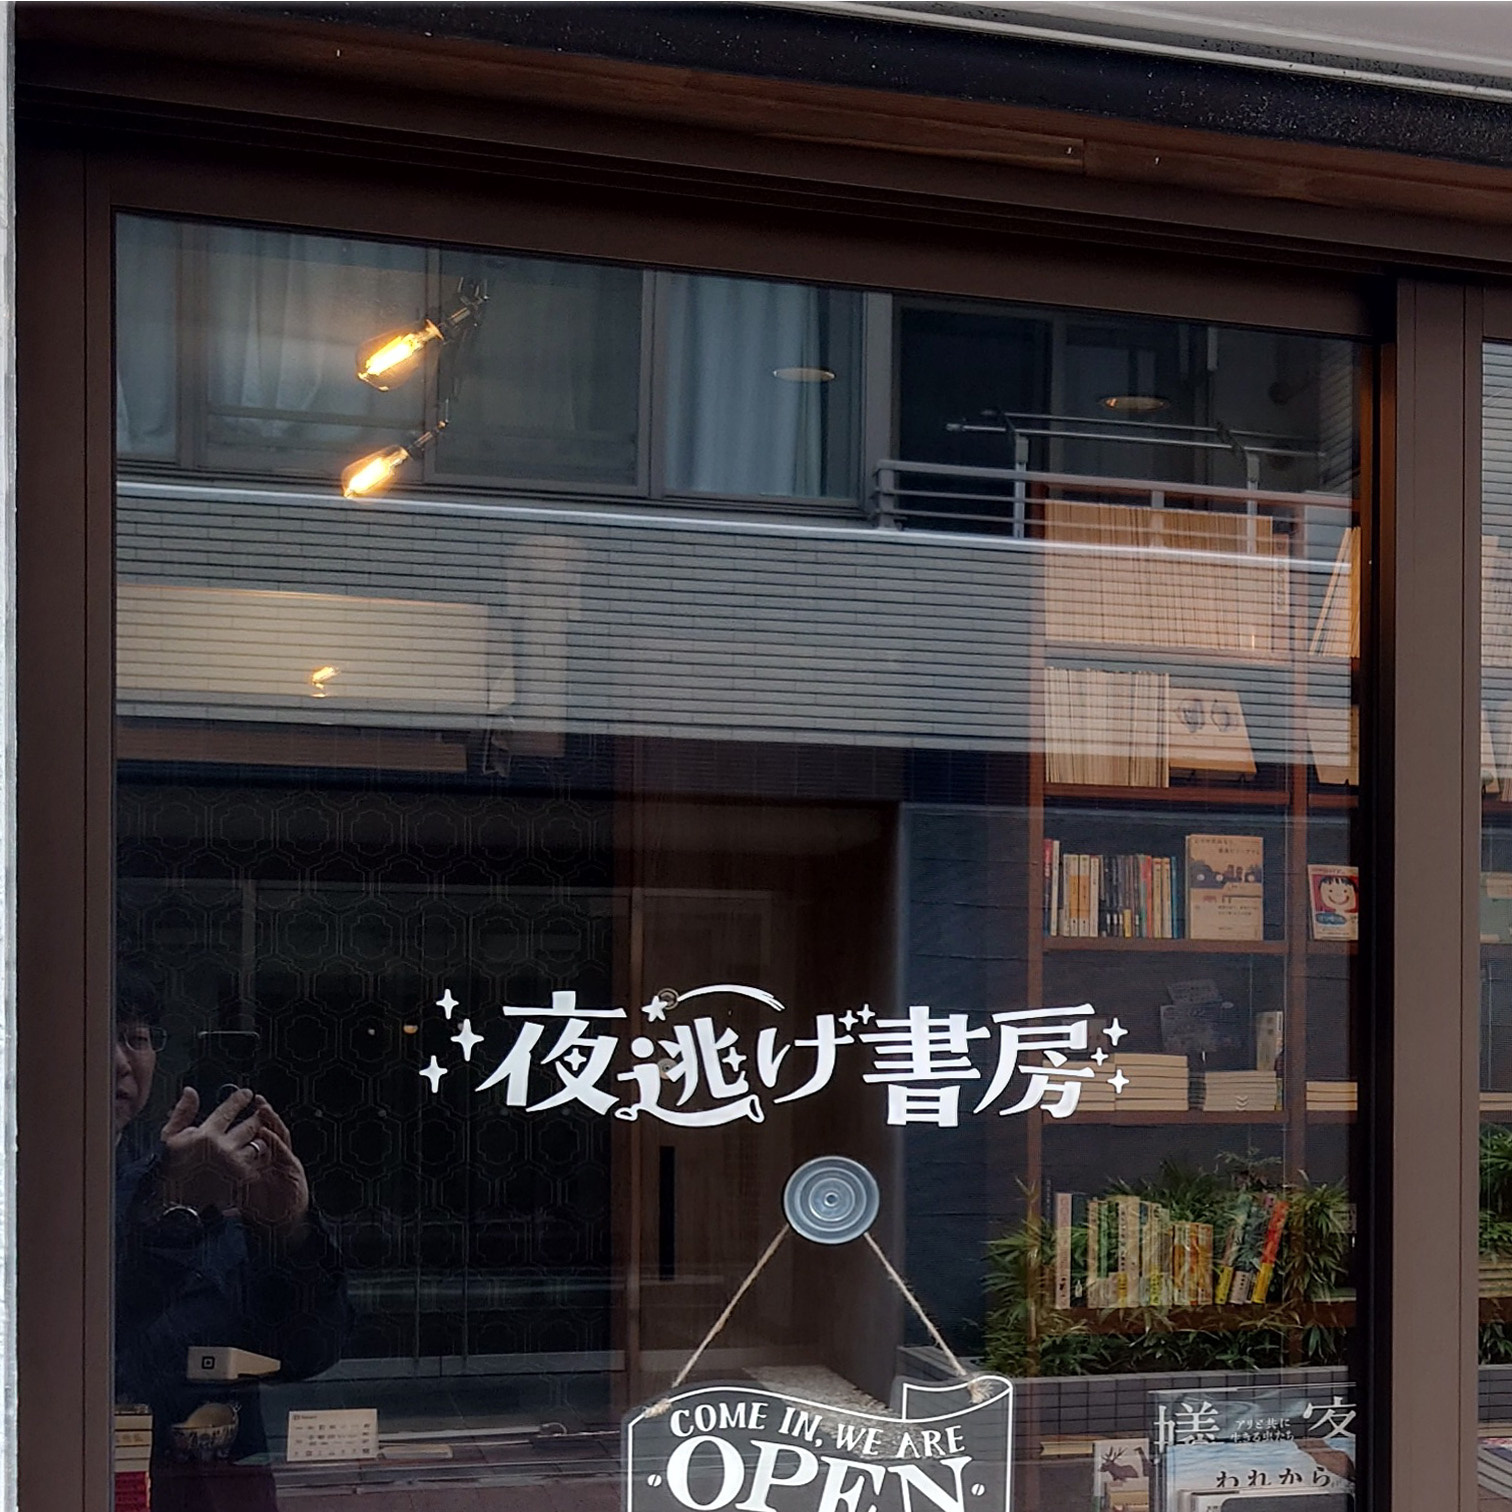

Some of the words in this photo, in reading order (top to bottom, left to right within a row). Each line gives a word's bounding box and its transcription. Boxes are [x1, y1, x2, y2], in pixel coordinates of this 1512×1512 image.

[474, 989, 1097, 1128] 夜逃げ書房
[670, 1401, 766, 1438] COME
[779, 1405, 823, 1448] IN,
[835, 1425, 884, 1453] WE
[899, 1424, 965, 1459] ARE
